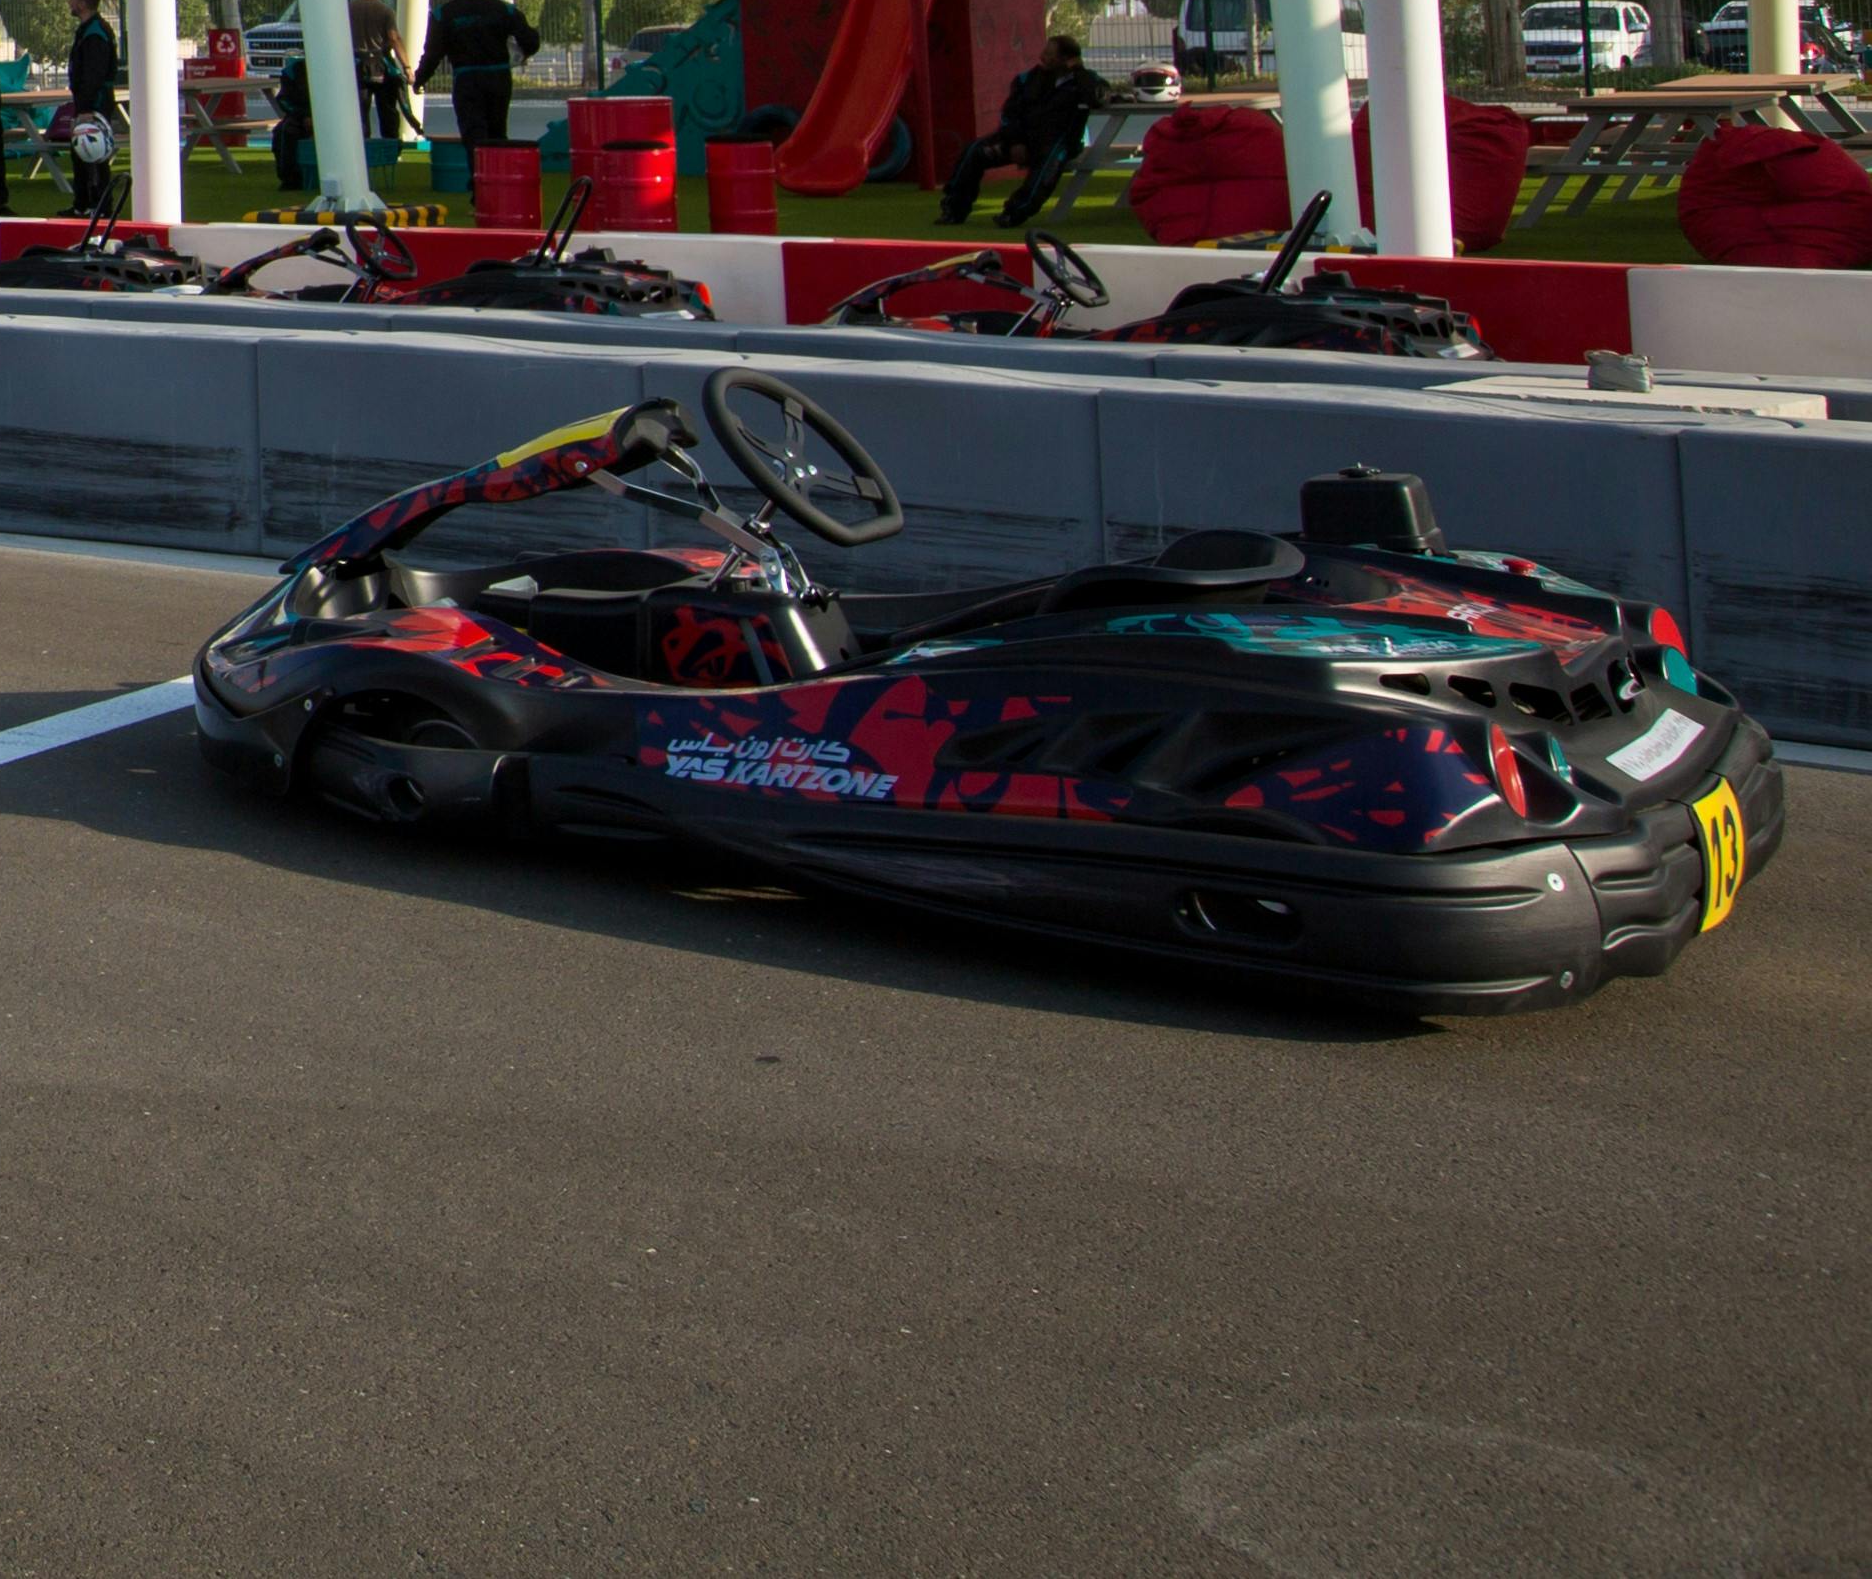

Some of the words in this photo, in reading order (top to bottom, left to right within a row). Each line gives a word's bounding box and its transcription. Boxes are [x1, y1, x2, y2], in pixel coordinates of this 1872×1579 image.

[665, 754, 729, 781] YAS
[724, 762, 899, 799] KARTZONE
[1711, 805, 1738, 909] 13
